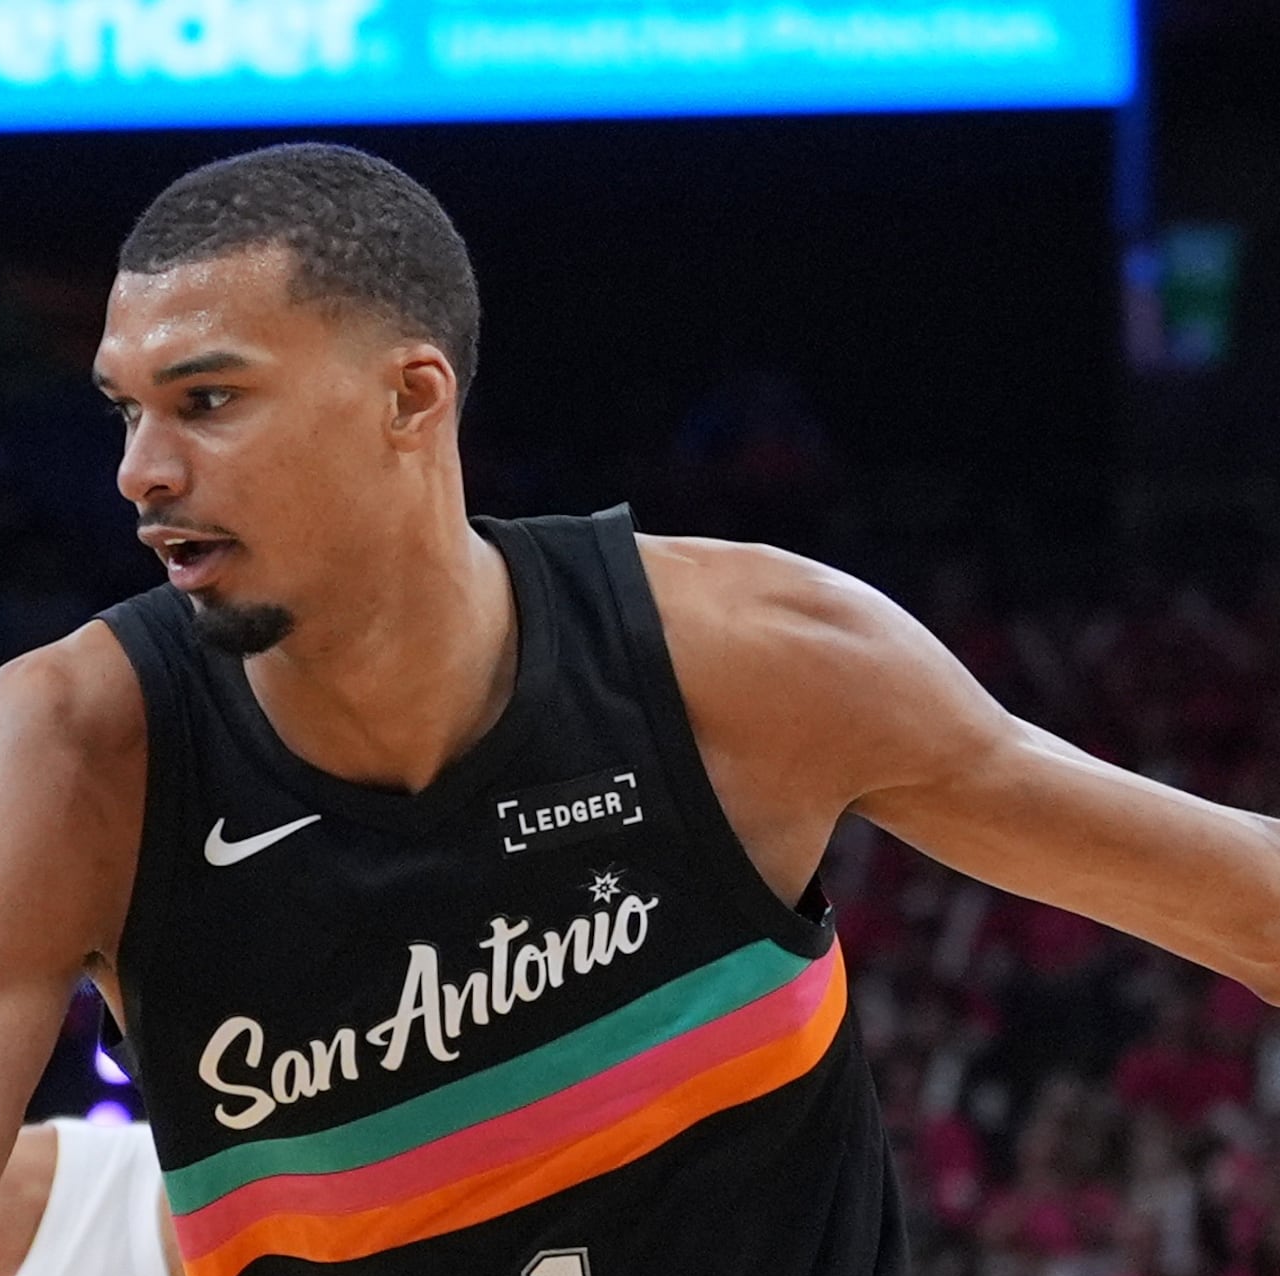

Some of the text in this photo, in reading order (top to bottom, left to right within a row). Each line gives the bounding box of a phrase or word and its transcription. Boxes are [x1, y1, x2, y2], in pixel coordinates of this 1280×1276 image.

[518, 790, 624, 836] LEDGER
[198, 894, 658, 1130] San Antonio
